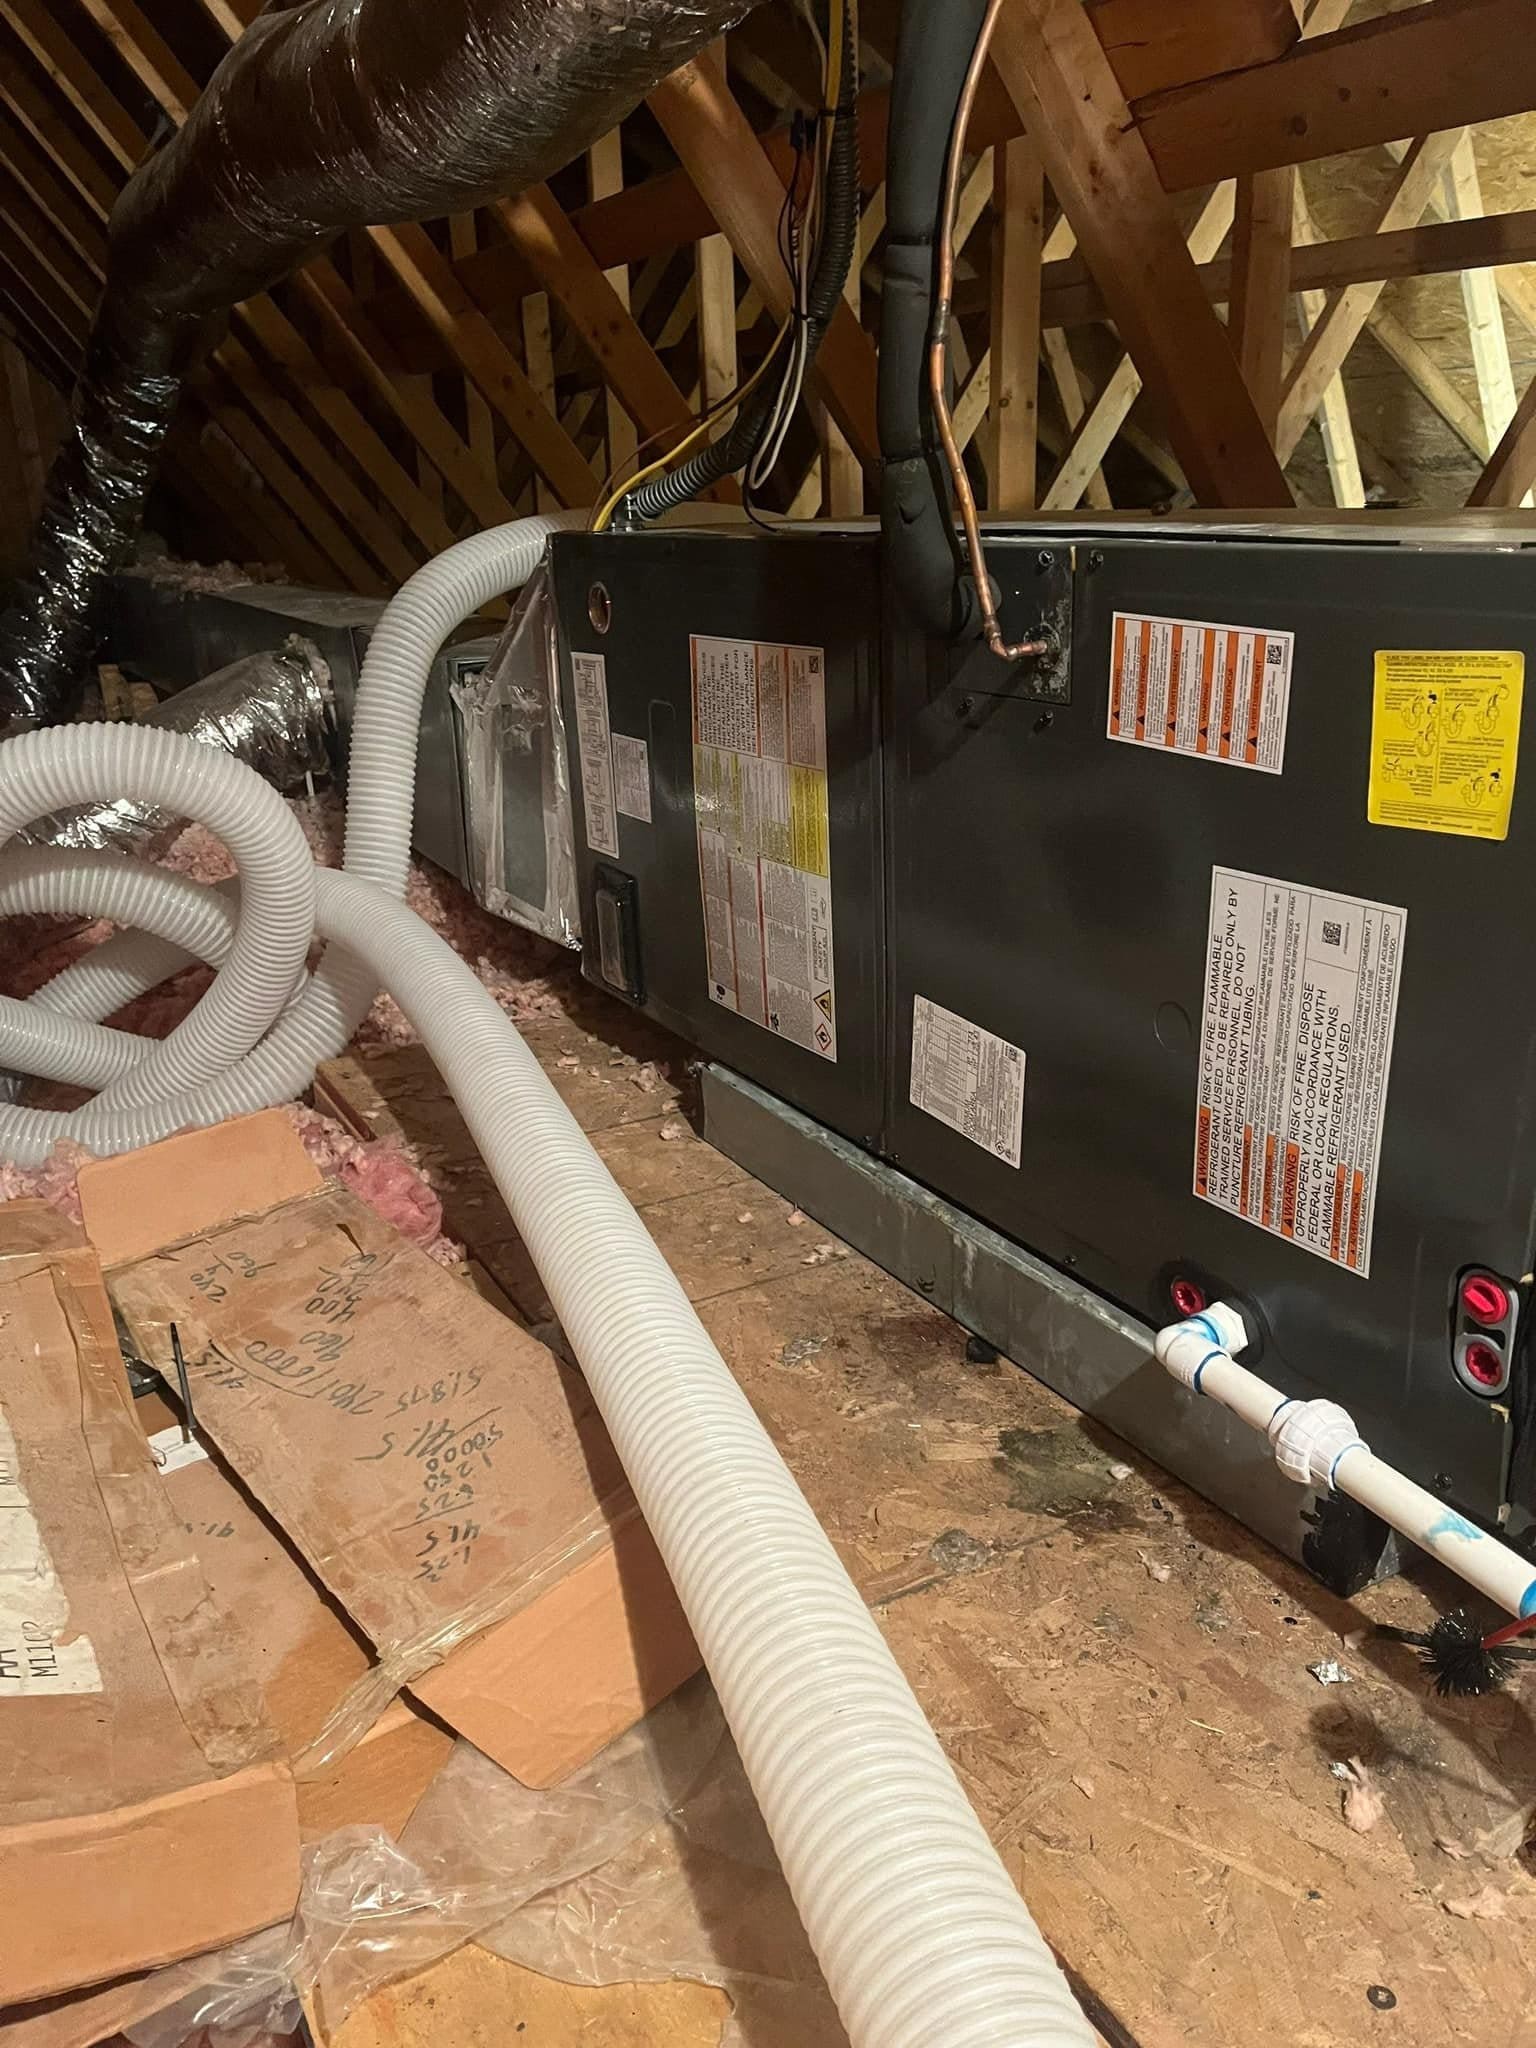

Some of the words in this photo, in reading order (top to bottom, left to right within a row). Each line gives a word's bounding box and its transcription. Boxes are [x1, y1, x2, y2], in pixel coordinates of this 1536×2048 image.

[1228, 887, 1238, 907] BY
[1225, 910, 1236, 948] ONLY
[1208, 933, 1222, 1015] FLAMMABLE
[1235, 942, 1246, 973] NOT
[1219, 949, 1233, 1020] REPAIRED
[1233, 975, 1243, 997] DO
[1313, 988, 1327, 1027] WITH
[1217, 1021, 1227, 1040] BE
[1241, 981, 1255, 1038] TUBING.
[1298, 980, 1314, 1045] DISPOSE
[1204, 1053, 1213, 1072] OF
[1216, 1042, 1225, 1062] TO
[1337, 1018, 1351, 1064] USED.
[1233, 1038, 1249, 1135] REFRIGERANT
[1294, 1047, 1306, 1084] FIRE.
[1303, 1028, 1322, 1129] ACCORDANCE
[1202, 1073, 1212, 1105] RISK
[1292, 1085, 1302, 1107] OF
[1222, 1086, 1233, 1144] SERVICE
[1289, 1107, 1300, 1141] RISK
[1302, 1129, 1312, 1145] IN
[1314, 1110, 1327, 1157] LOCAL
[1326, 1064, 1346, 1167] REFRIGERANT
[1198, 1115, 1209, 1176] WARNING
[1207, 1105, 1221, 1196] REFRIGERANT
[1312, 1157, 1323, 1180] OR
[1218, 1144, 1230, 1201] TRAINED
[1229, 1135, 1243, 1206] PUNCTURE
[1283, 1151, 1297, 1217] WARNING
[1294, 1144, 1311, 1238] OFPROPERLY
[1306, 1181, 1321, 1244] FEDERAL
[1319, 1167, 1336, 1250] FLAMMABLE
[190, 1273, 228, 1304] 240
[304, 1297, 357, 1325] 400
[383, 1366, 481, 1420] 51.875
[353, 1418, 455, 1459] 41.5
[415, 1519, 481, 1558] 41.5
